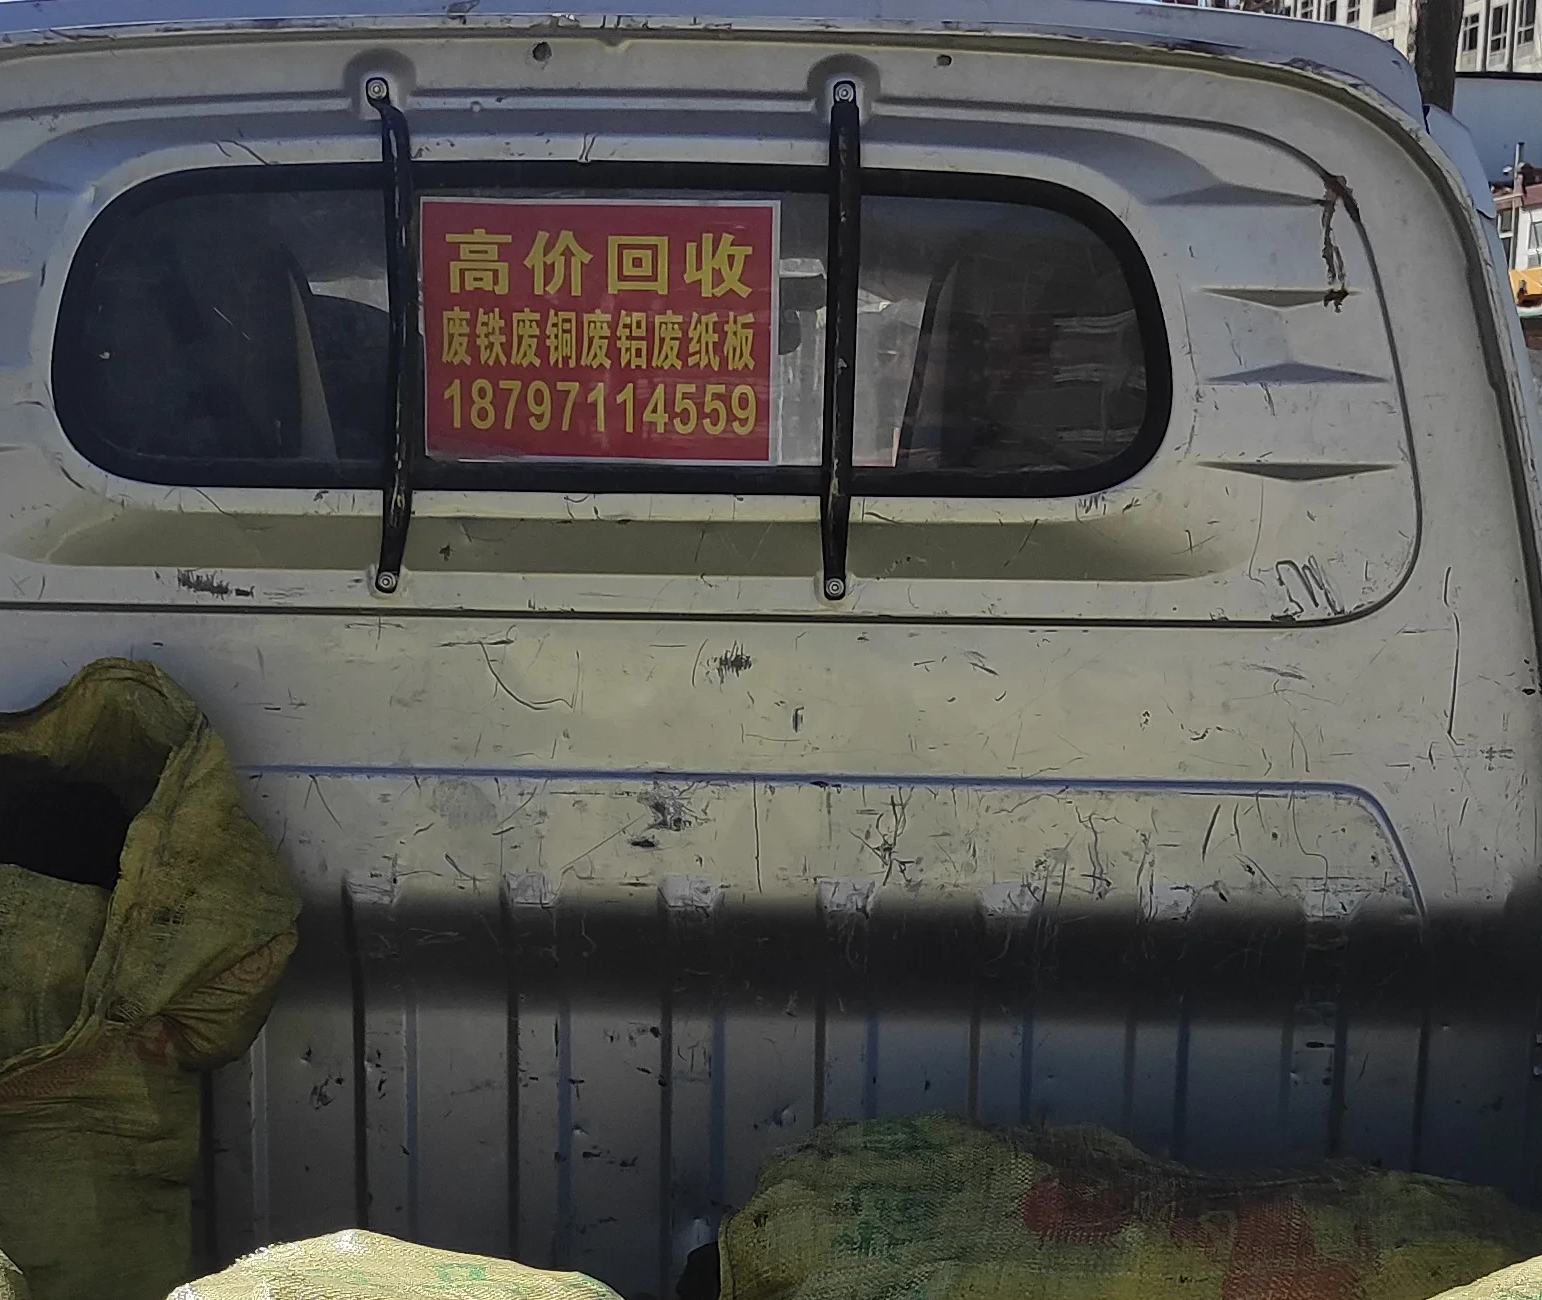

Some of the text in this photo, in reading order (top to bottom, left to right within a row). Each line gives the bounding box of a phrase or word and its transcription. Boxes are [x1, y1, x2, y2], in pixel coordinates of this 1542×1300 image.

[445, 229, 754, 298] 高价回收
[442, 307, 756, 371] 废铁废铜废铝废纸板
[443, 379, 757, 435] 18797114559
